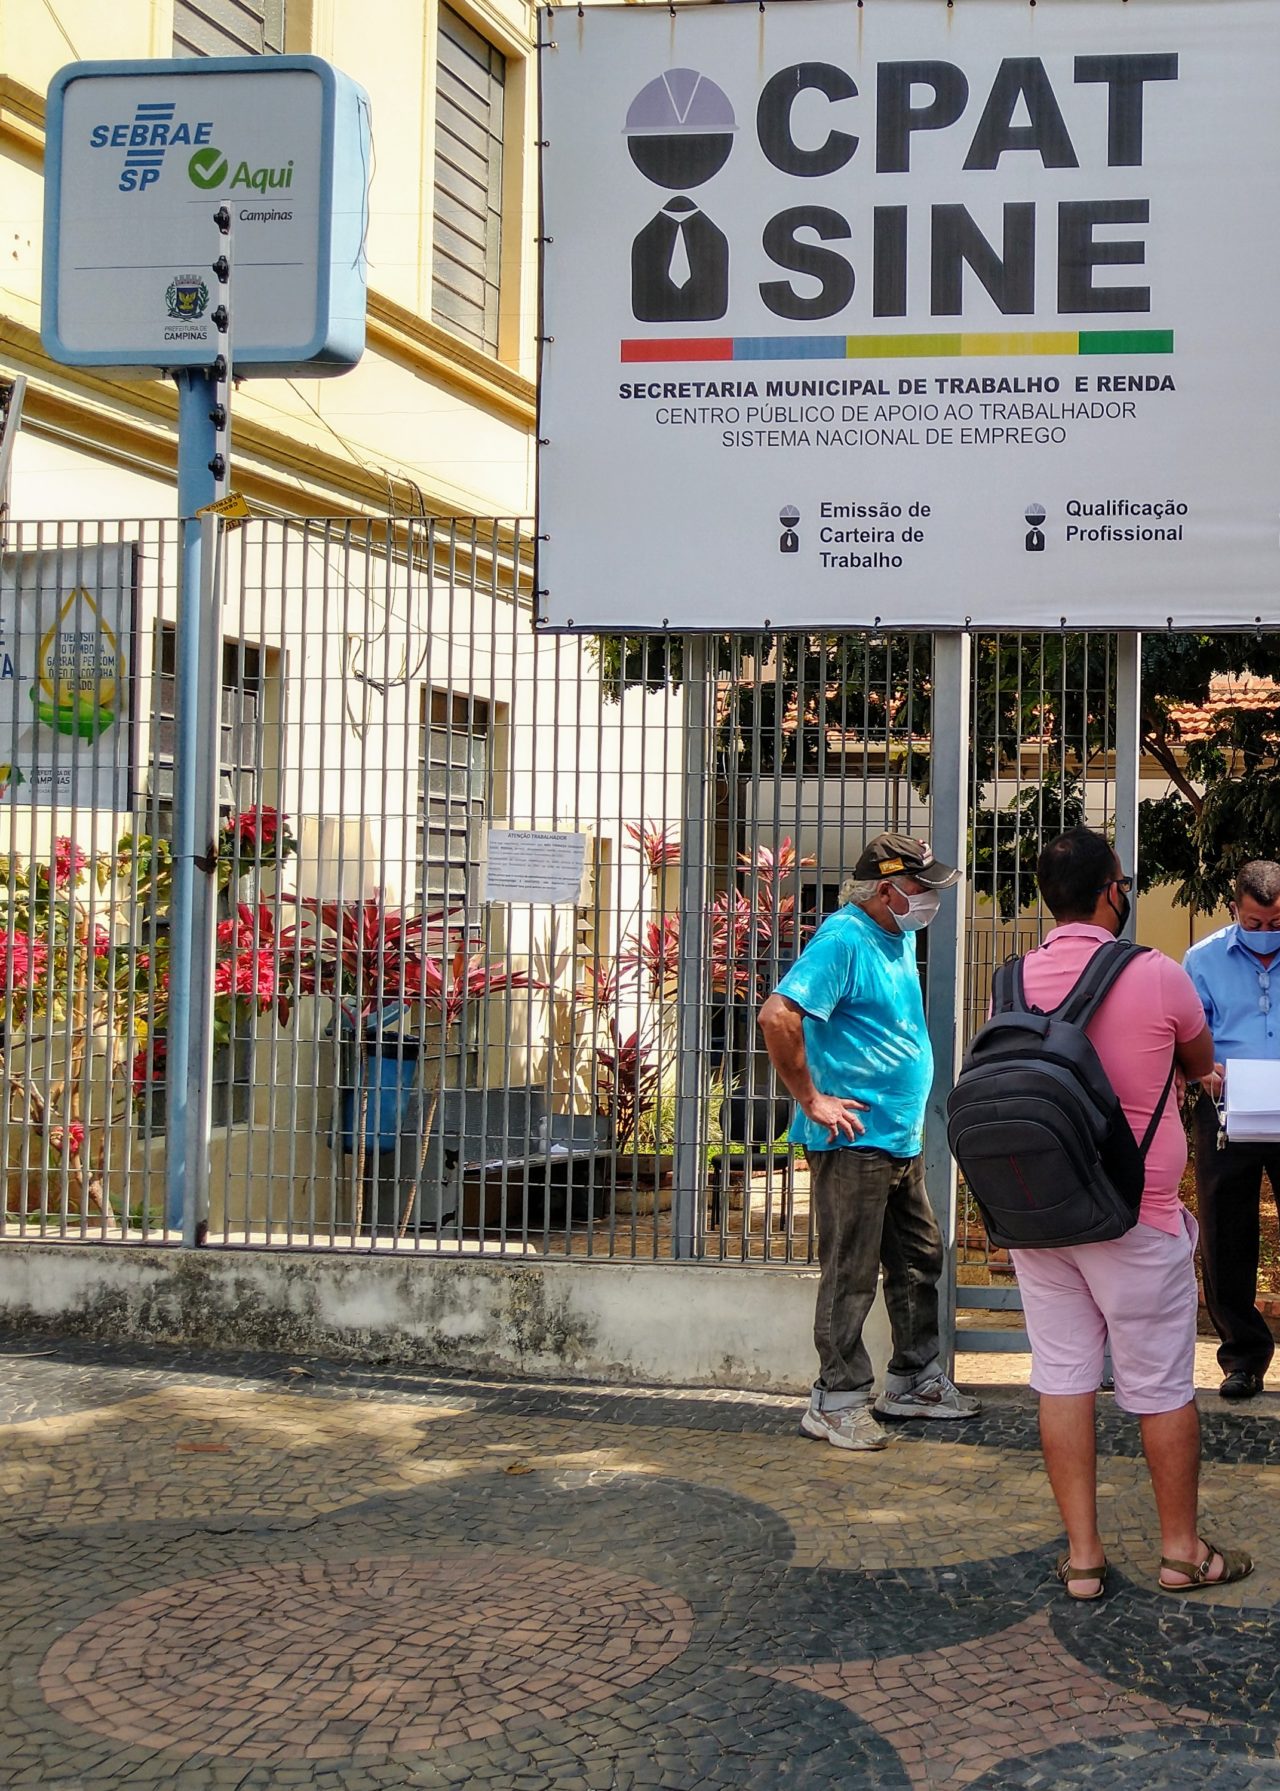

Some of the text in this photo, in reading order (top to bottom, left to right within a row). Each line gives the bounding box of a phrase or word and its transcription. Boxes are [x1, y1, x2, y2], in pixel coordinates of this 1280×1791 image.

[757, 53, 1178, 177] CPAT
[90, 122, 213, 148] SEBRAE
[118, 160, 294, 194] SP Aqui
[239, 208, 293, 224] Campinas
[759, 199, 1150, 320] SINE
[164, 332, 208, 340] CAMPINAS
[619, 375, 1175, 399] SECRETARIA MUNICIPAL DE TRABALHO E RENDA
[656, 402, 1136, 424] CENTRO PÚBLICO DE APOIO AO TRABALHADOR
[723, 427, 1066, 447] SISTEMA NACIONAL DE EMPREGO
[821, 502, 930, 517] Emissão de
[1067, 500, 1187, 519] Qualificação
[820, 527, 923, 542] Carteira de
[1067, 525, 1182, 541] Profissional
[820, 552, 902, 567] Trabalho
[100, 656, 114, 666] OM
